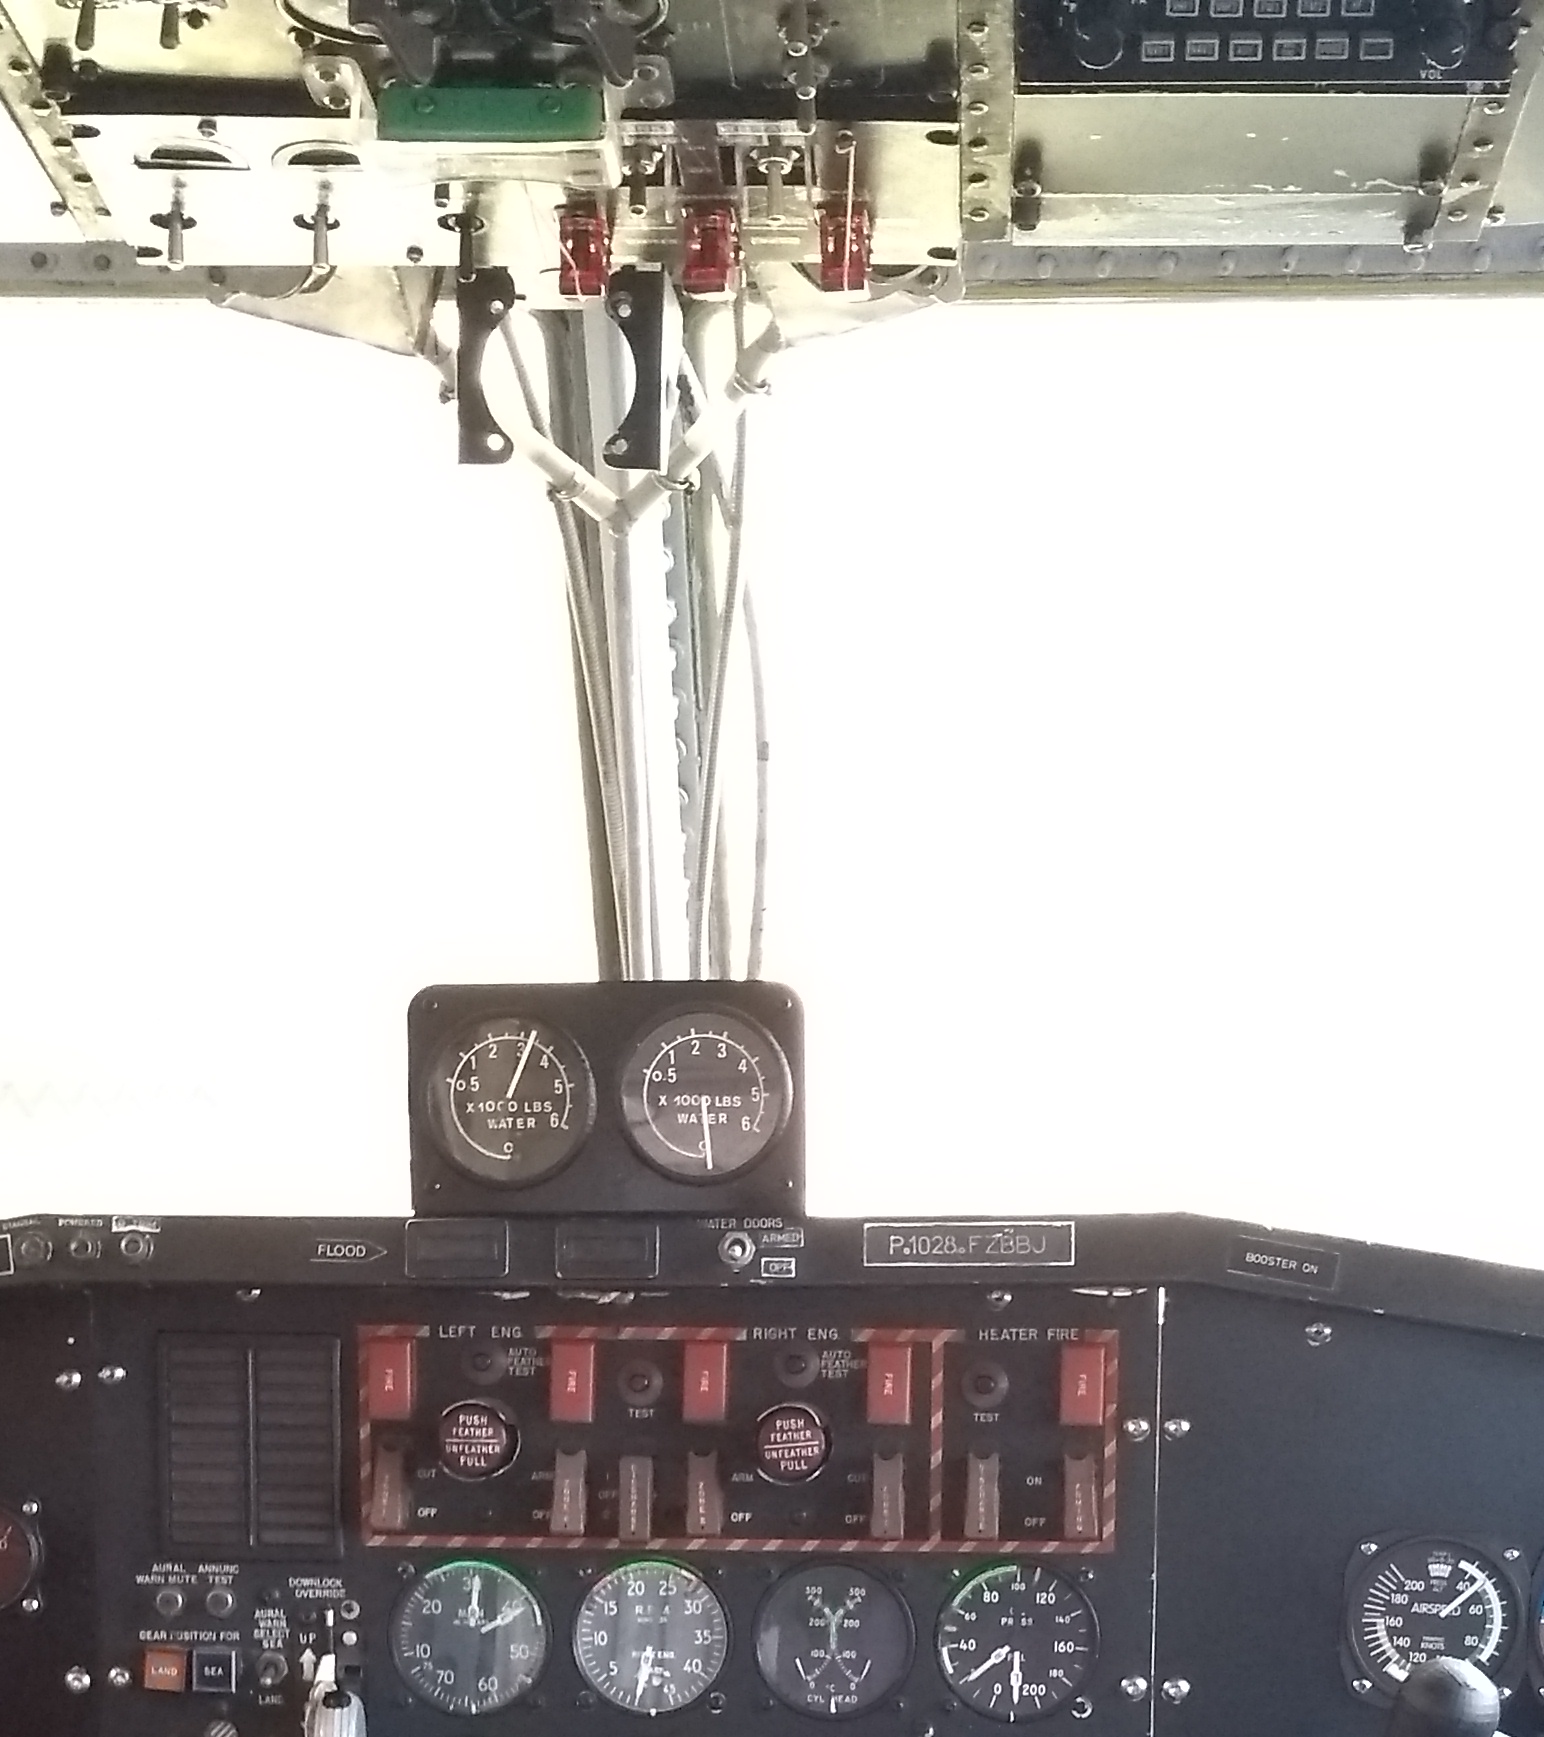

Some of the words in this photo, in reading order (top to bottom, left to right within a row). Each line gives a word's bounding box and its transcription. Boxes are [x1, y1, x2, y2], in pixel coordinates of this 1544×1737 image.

[524, 1101, 552, 1113] LBS
[659, 1095, 668, 1106] X
[715, 1096, 742, 1108] LBS
[487, 1118, 536, 1130] WATER
[743, 1217, 783, 1229] DOORS
[761, 1232, 799, 1245] ARMED
[317, 1244, 367, 1258] FLOOD
[1245, 1252, 1297, 1271] BOOSTER
[1302, 1262, 1319, 1275] ON
[439, 1326, 476, 1339] LEFT
[491, 1326, 522, 1339] ENG
[753, 1327, 797, 1341] RIGHT
[807, 1328, 838, 1341] ENG
[979, 1328, 1038, 1341] HEATER
[1047, 1328, 1079, 1341] FIRE
[822, 1350, 852, 1359] AUTO
[821, 1359, 867, 1369] FEATHER
[508, 1367, 536, 1376] TEST
[821, 1369, 848, 1378] TEST
[885, 1373, 894, 1396] FIRE
[1077, 1374, 1087, 1397] FIRE
[628, 1408, 655, 1418] TEST
[973, 1413, 999, 1423] TEST
[459, 1414, 488, 1426] PUSH
[776, 1418, 805, 1431] PUSH
[453, 1427, 494, 1438] FEATHER
[770, 1429, 812, 1443] FEATHER
[445, 1443, 501, 1454] UNFEATHER
[764, 1446, 820, 1460] UNFEATHER
[460, 1455, 487, 1467] PULL
[780, 1459, 808, 1472] PULL
[1027, 1476, 1042, 1486] ON
[418, 1508, 438, 1518] OFF
[731, 1512, 752, 1522] OFF
[1024, 1517, 1046, 1527] OFF
[152, 1564, 186, 1573] AURAL
[136, 1575, 165, 1584] WARN
[168, 1575, 197, 1584] MUTE
[208, 1575, 233, 1584] TEST
[289, 1578, 343, 1588] DOWNLOCK
[1404, 1580, 1425, 1591] 200
[295, 1589, 346, 1598] OVERRIDE
[627, 1581, 645, 1596] 20
[659, 1581, 677, 1595] 25
[983, 1592, 999, 1603] 80
[1036, 1593, 1056, 1604] 120
[1391, 1593, 1408, 1604] 180
[422, 1599, 442, 1614] 20
[604, 1601, 617, 1615] 15
[685, 1600, 702, 1614] 30
[1411, 1602, 1461, 1616] AIRSPED
[1469, 1604, 1483, 1615] 60
[254, 1610, 287, 1619] AURAL
[1055, 1616, 1070, 1624] 140
[258, 1619, 287, 1628] WARN
[1385, 1616, 1403, 1628] 160
[139, 1631, 167, 1640] GEAR
[220, 1632, 240, 1641] FOR
[299, 1633, 317, 1644] UP
[594, 1631, 607, 1646] 10
[694, 1630, 711, 1644] 35
[1393, 1636, 1410, 1648] 140
[1464, 1635, 1478, 1647] 80
[262, 1640, 283, 1649] SEA
[415, 1643, 431, 1658] 10
[959, 1639, 976, 1651] 40
[1054, 1641, 1074, 1653] 160
[510, 1644, 529, 1659] 50
[1409, 1652, 1427, 1662] 120
[151, 1666, 177, 1675] LAND
[204, 1667, 224, 1676] SEA
[683, 1659, 702, 1673] 40
[437, 1670, 454, 1685] 70
[478, 1677, 498, 1692] 60
[1022, 1683, 1046, 1695] 200
[807, 1694, 825, 1703] CYL
